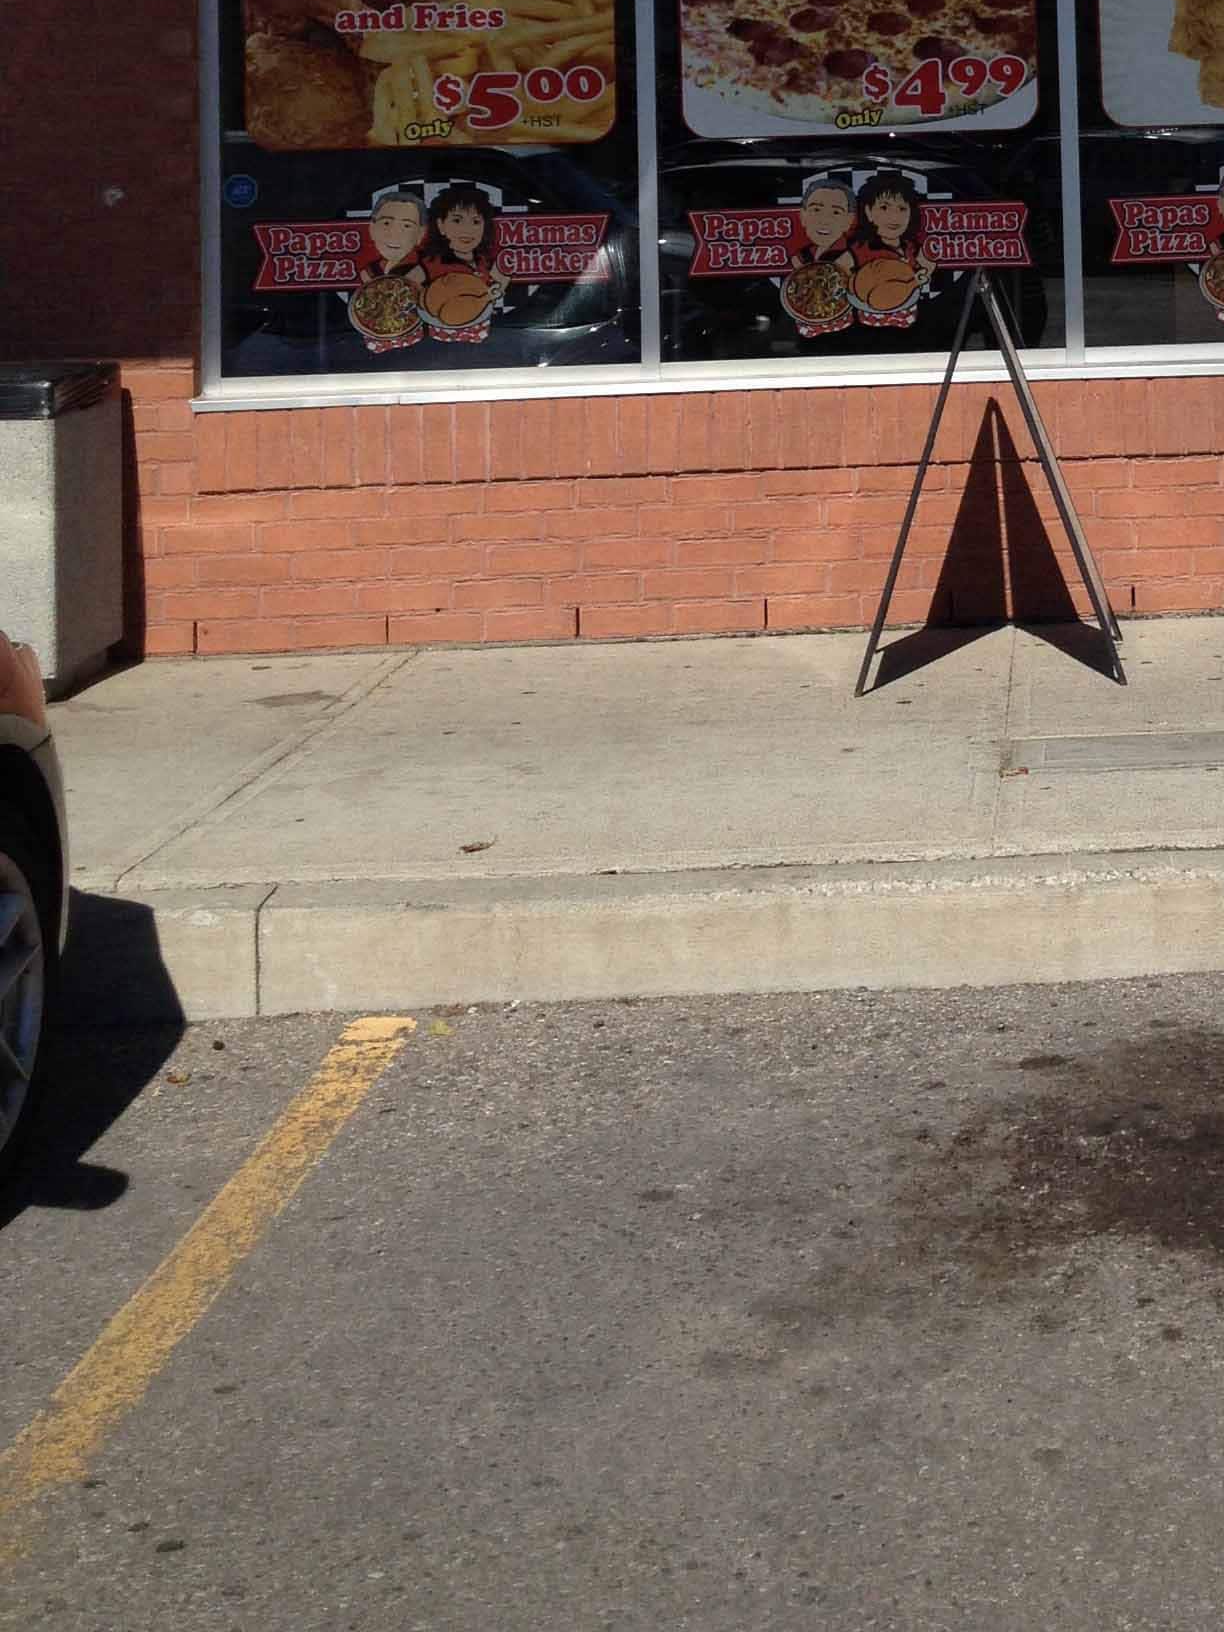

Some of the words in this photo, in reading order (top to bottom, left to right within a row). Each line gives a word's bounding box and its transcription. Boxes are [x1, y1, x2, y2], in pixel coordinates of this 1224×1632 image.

[336, 4, 404, 32] and
[413, 2, 504, 30] Fries
[405, 119, 455, 140] Only
[835, 109, 884, 129] Only
[703, 215, 792, 242] Papas
[924, 208, 1019, 234] Mamas
[1123, 202, 1210, 229] Papas
[270, 227, 362, 257] Papas
[500, 220, 596, 245] Mamas
[1128, 229, 1207, 255] Pizza
[708, 243, 788, 268] Pizza
[922, 233, 1023, 261] Chicken
[274, 256, 358, 283] Pizza
